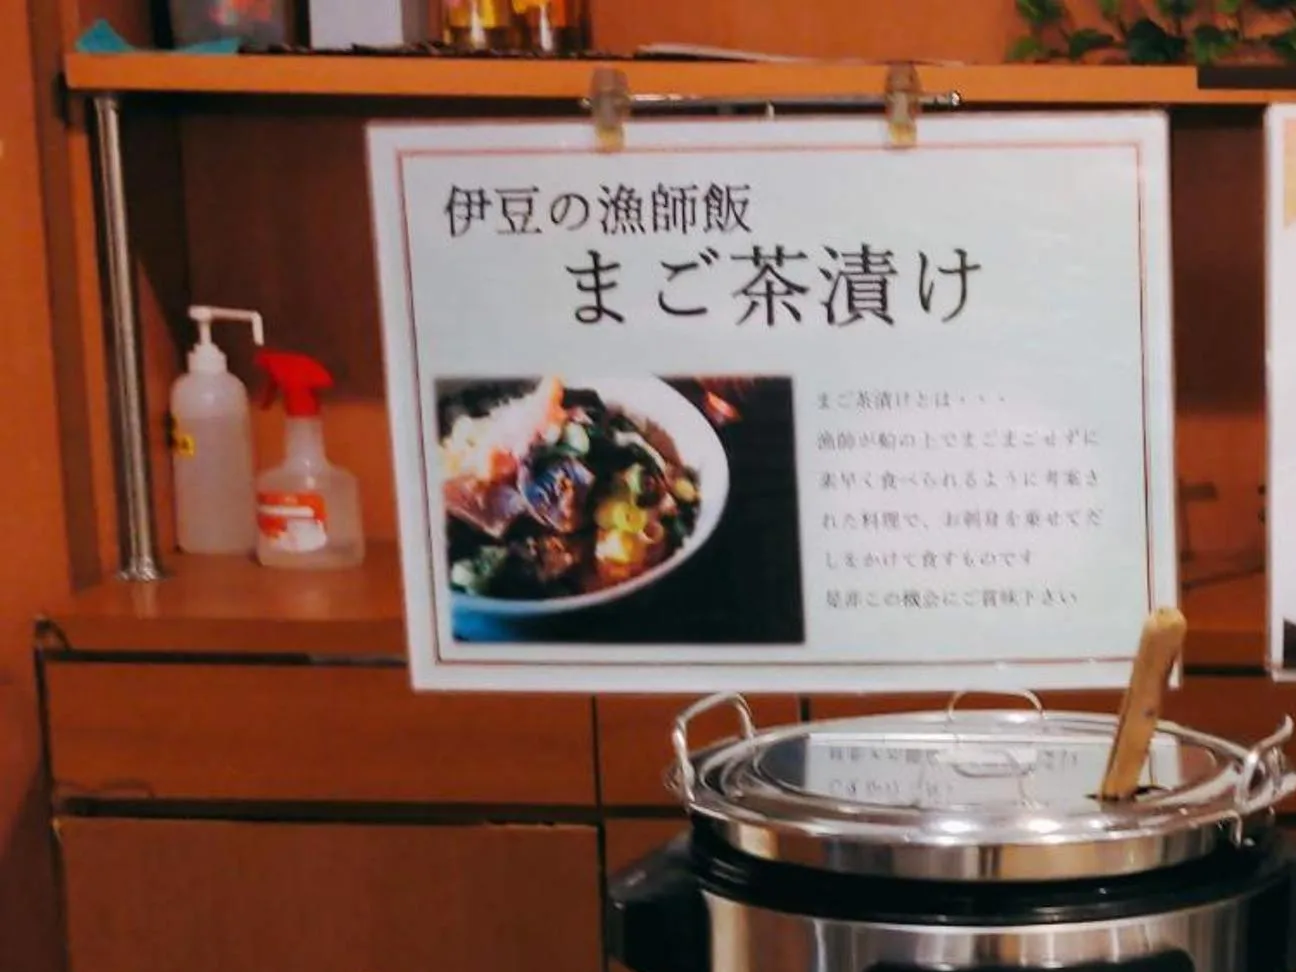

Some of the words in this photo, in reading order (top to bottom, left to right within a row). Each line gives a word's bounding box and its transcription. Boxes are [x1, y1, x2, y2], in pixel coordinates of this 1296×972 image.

[445, 183, 752, 236] 伊豆の漁師飯
[566, 243, 981, 327] まご茶漬け
